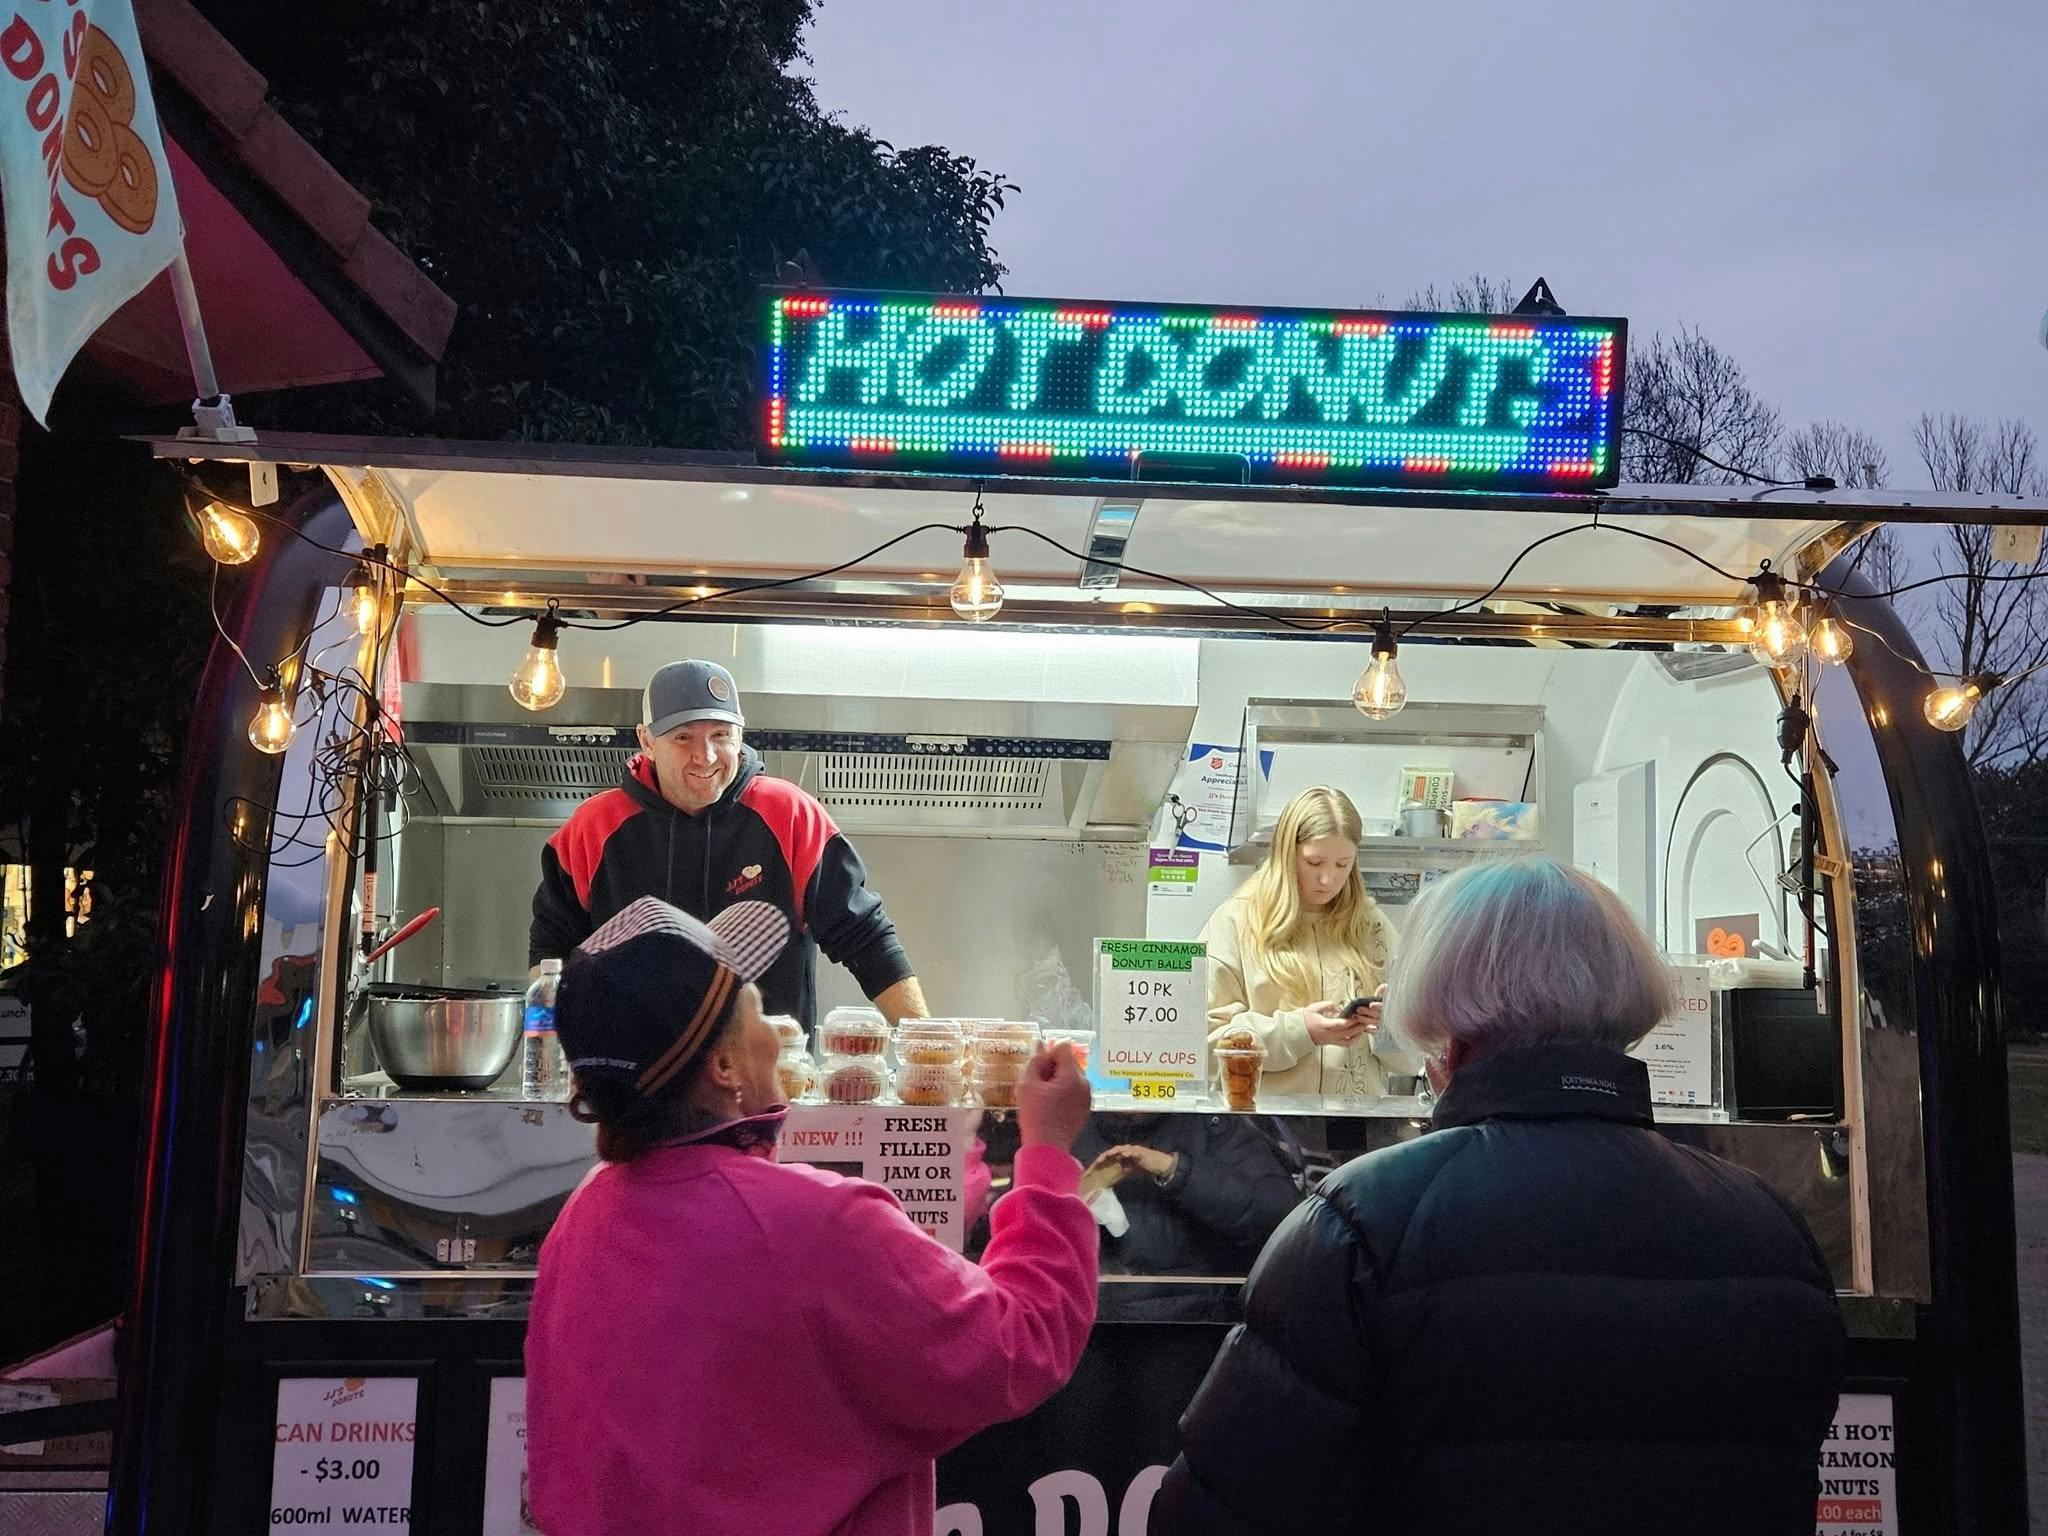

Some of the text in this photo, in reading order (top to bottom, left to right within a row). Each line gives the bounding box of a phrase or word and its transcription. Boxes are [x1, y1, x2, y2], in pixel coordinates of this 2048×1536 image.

[0, 12, 101, 291] DONTS
[799, 308, 1083, 412] HOT
[1428, 776, 1441, 809] COMPOS
[1101, 942, 1206, 955] FRESH CINNAMON
[1112, 958, 1192, 970] DONUT BALLS
[1128, 981, 1173, 997] 10 PK
[1679, 998, 1708, 1011] RED
[1124, 1005, 1178, 1024] $7.00
[1107, 1050, 1197, 1065] LOLLY CUPS
[1132, 1084, 1176, 1098] $3.50
[884, 1117, 948, 1132] FRESH
[792, 1132, 839, 1147] NEW
[879, 1142, 952, 1157] FILLED
[883, 1166, 952, 1183] JAM OR
[893, 1188, 957, 1202] RAMEL
[909, 1211, 949, 1225] NUTS
[274, 1422, 416, 1443] CAN DRINKS
[1844, 1424, 1892, 1441] HOT
[1819, 1451, 1895, 1469] AMON
[315, 1457, 380, 1483] $3.00
[1819, 1479, 1879, 1496] NUTS
[271, 1506, 411, 1525] 600ml WATER
[1817, 1505, 1881, 1520] .00 each
